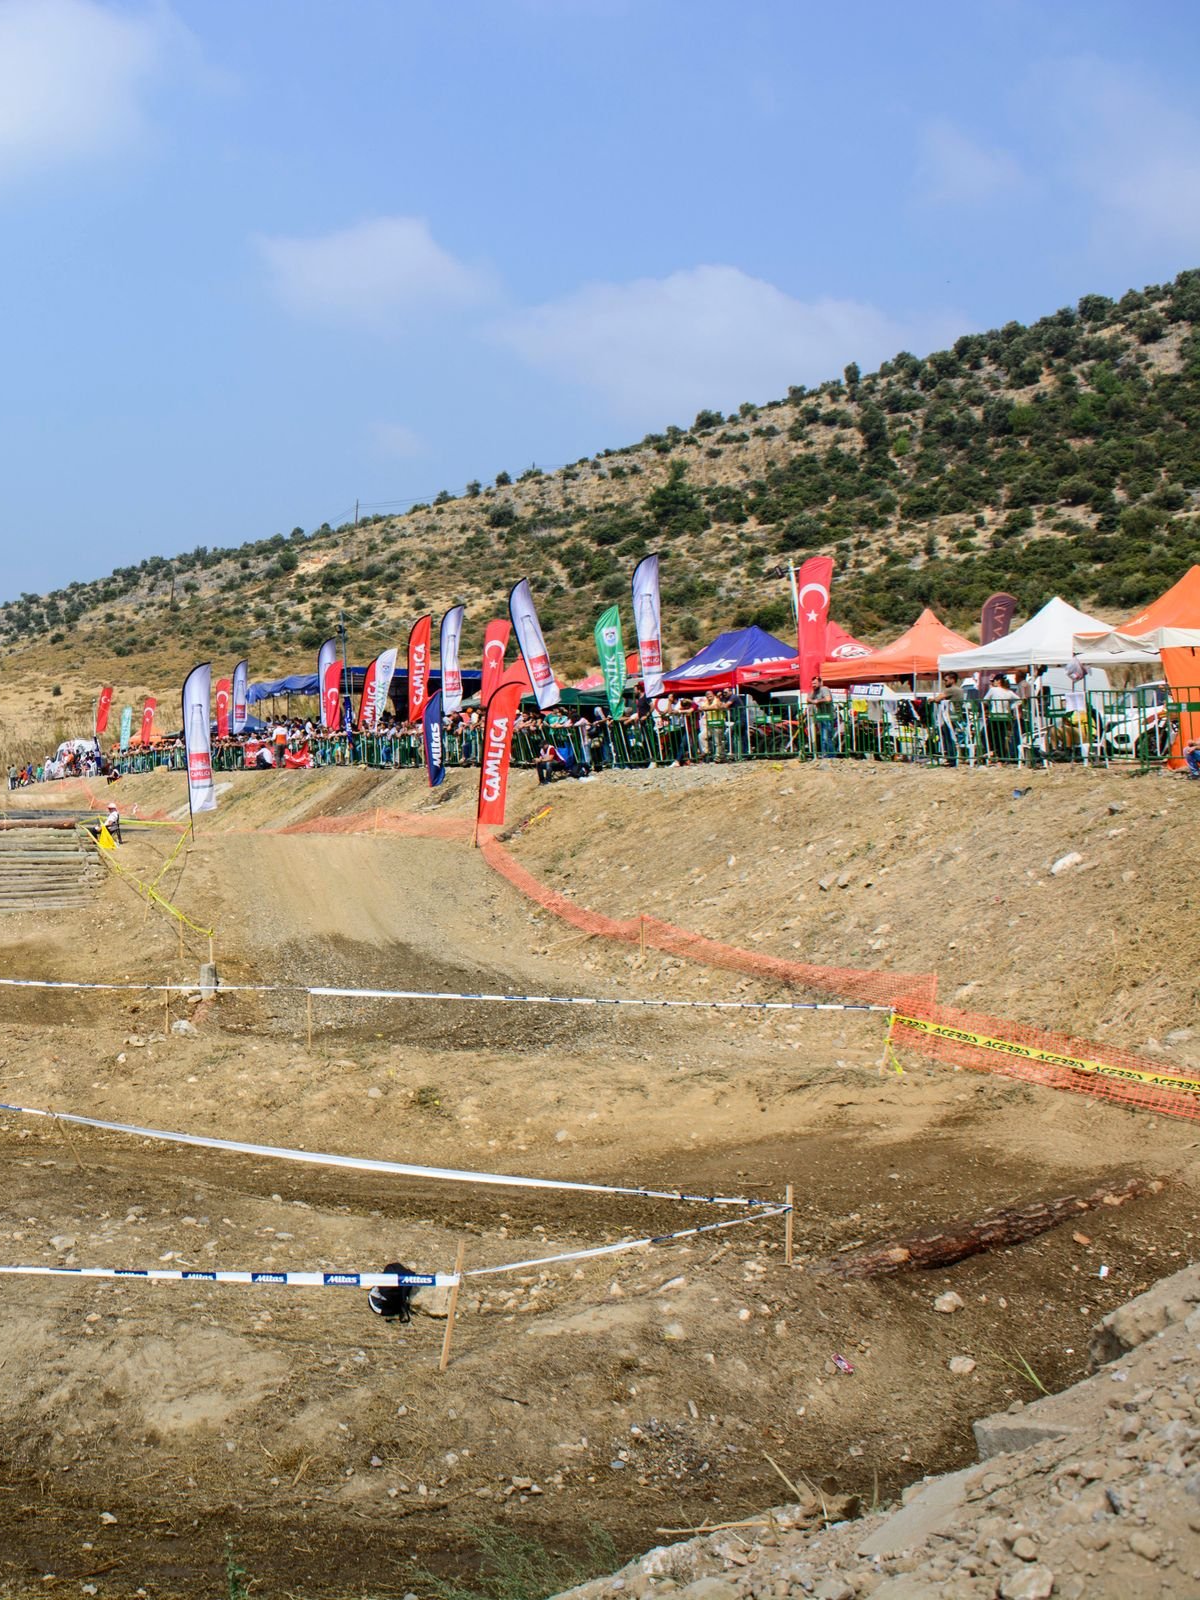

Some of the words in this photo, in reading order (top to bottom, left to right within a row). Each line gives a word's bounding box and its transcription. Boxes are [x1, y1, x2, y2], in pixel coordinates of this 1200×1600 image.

[431, 722, 441, 768] Mitas
[255, 1274, 284, 1282] Mitas
[326, 1275, 357, 1284] Mitas
[401, 1276, 433, 1284] Mitas
